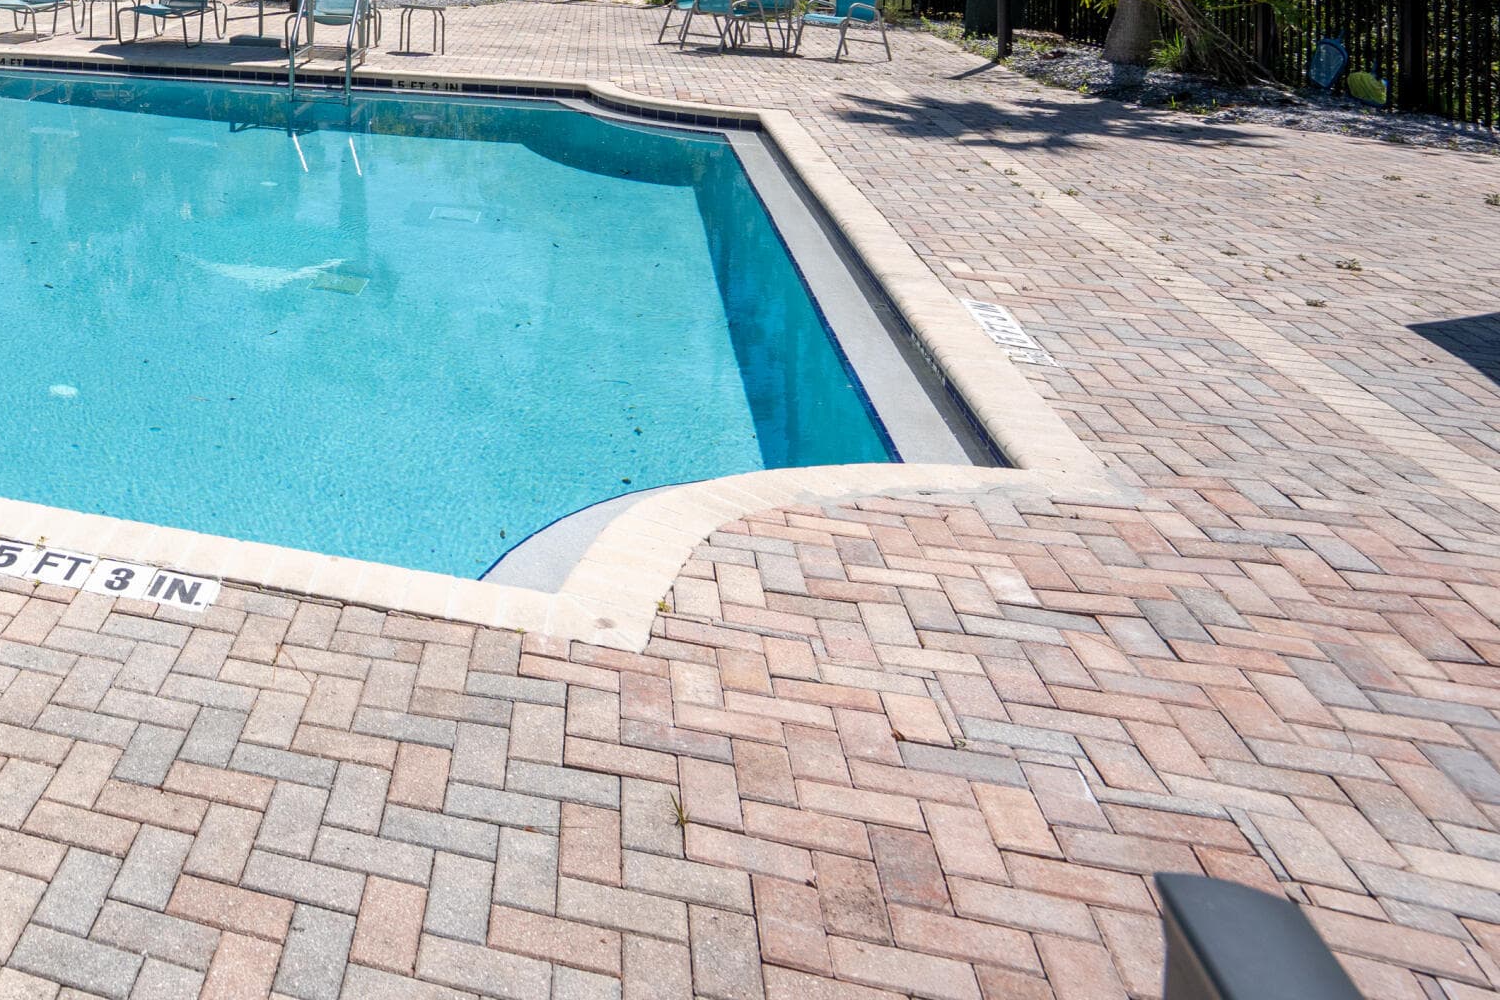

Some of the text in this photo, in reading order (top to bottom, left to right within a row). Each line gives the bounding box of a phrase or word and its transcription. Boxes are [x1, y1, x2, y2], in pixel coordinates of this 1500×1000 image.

[31, 551, 93, 581] FT
[104, 567, 136, 591] 3
[147, 574, 203, 607] IN.
